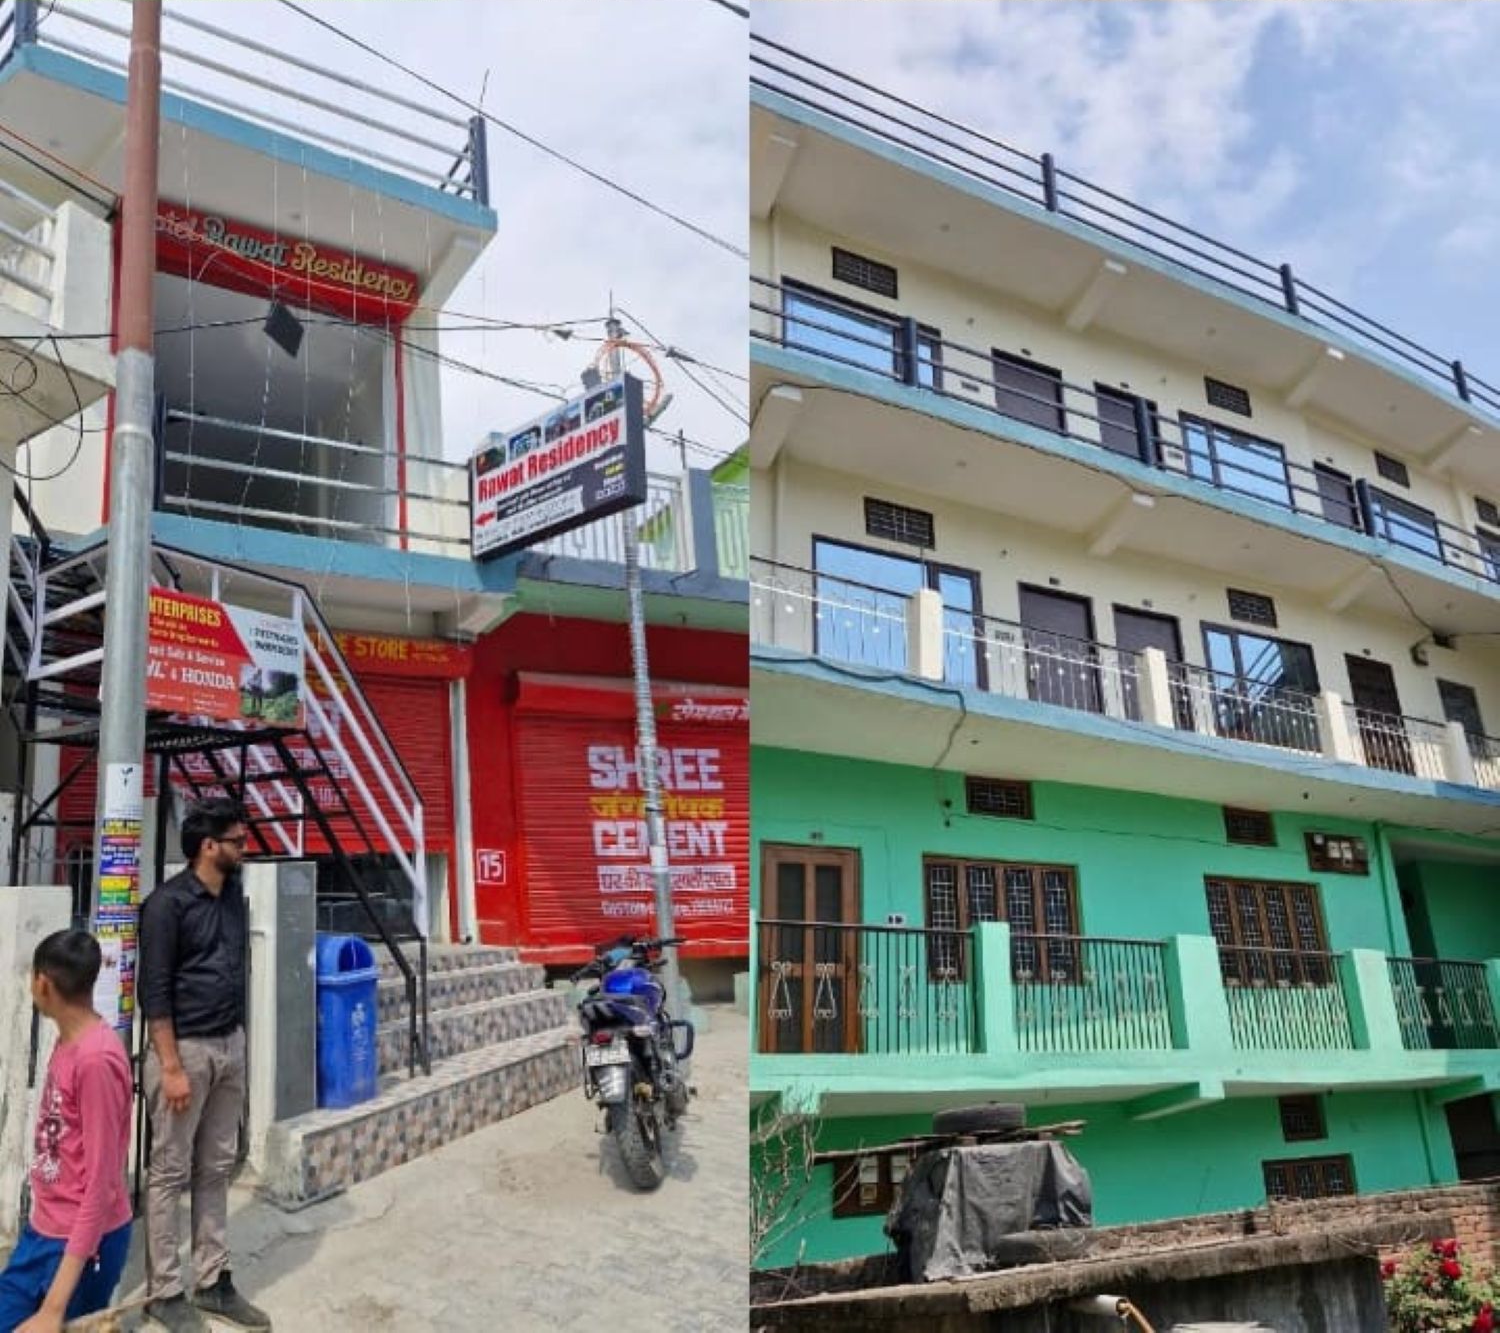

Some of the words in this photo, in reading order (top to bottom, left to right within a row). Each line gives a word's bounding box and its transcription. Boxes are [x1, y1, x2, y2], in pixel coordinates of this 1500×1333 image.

[155, 209, 203, 242] otel
[291, 242, 413, 300] Residency
[478, 462, 524, 503] Rawat
[528, 416, 620, 478] Residency
[149, 595, 222, 628] NTERPRISES
[354, 637, 409, 661] STORE
[182, 667, 236, 690] HONDA
[587, 745, 723, 790] SHREE
[479, 854, 503, 878] 15
